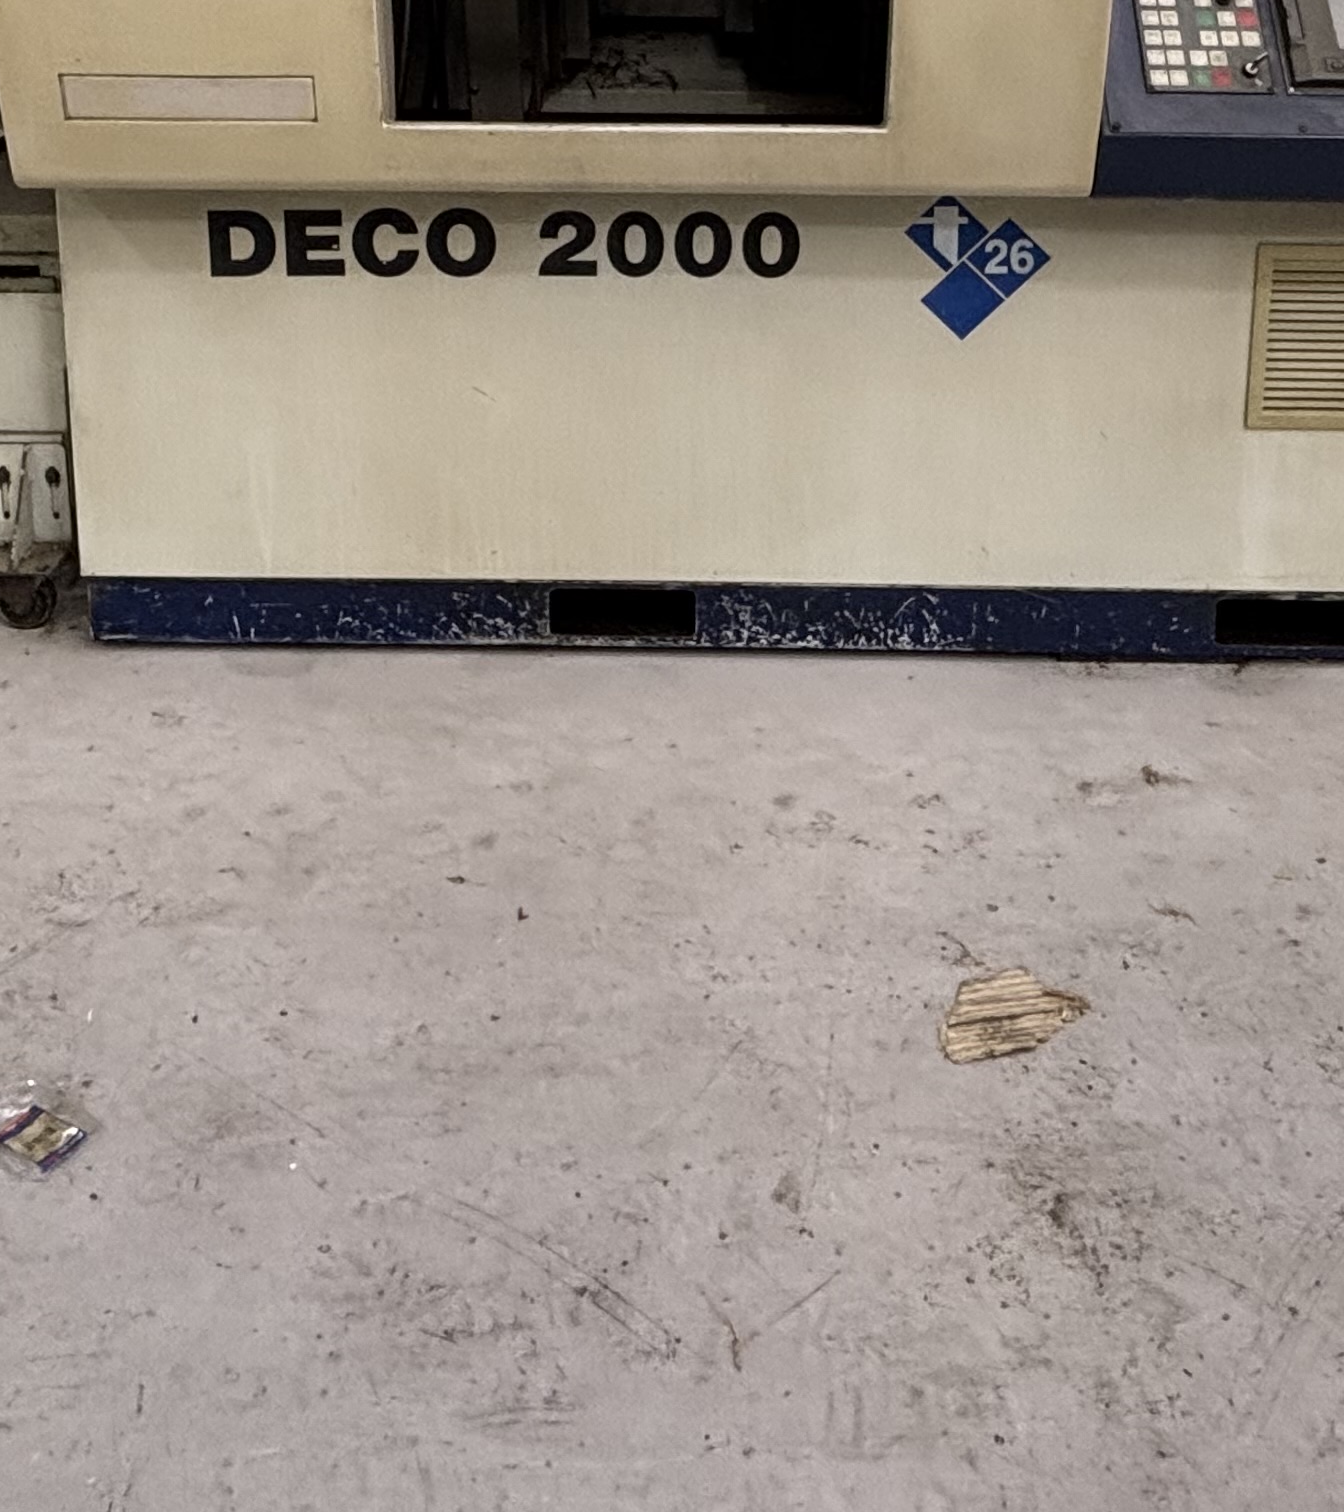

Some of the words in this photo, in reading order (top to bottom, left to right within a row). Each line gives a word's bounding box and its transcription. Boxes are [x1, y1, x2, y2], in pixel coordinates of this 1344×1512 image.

[207, 207, 497, 278] DECO
[538, 209, 801, 279] 2000
[984, 238, 1035, 275] 26
